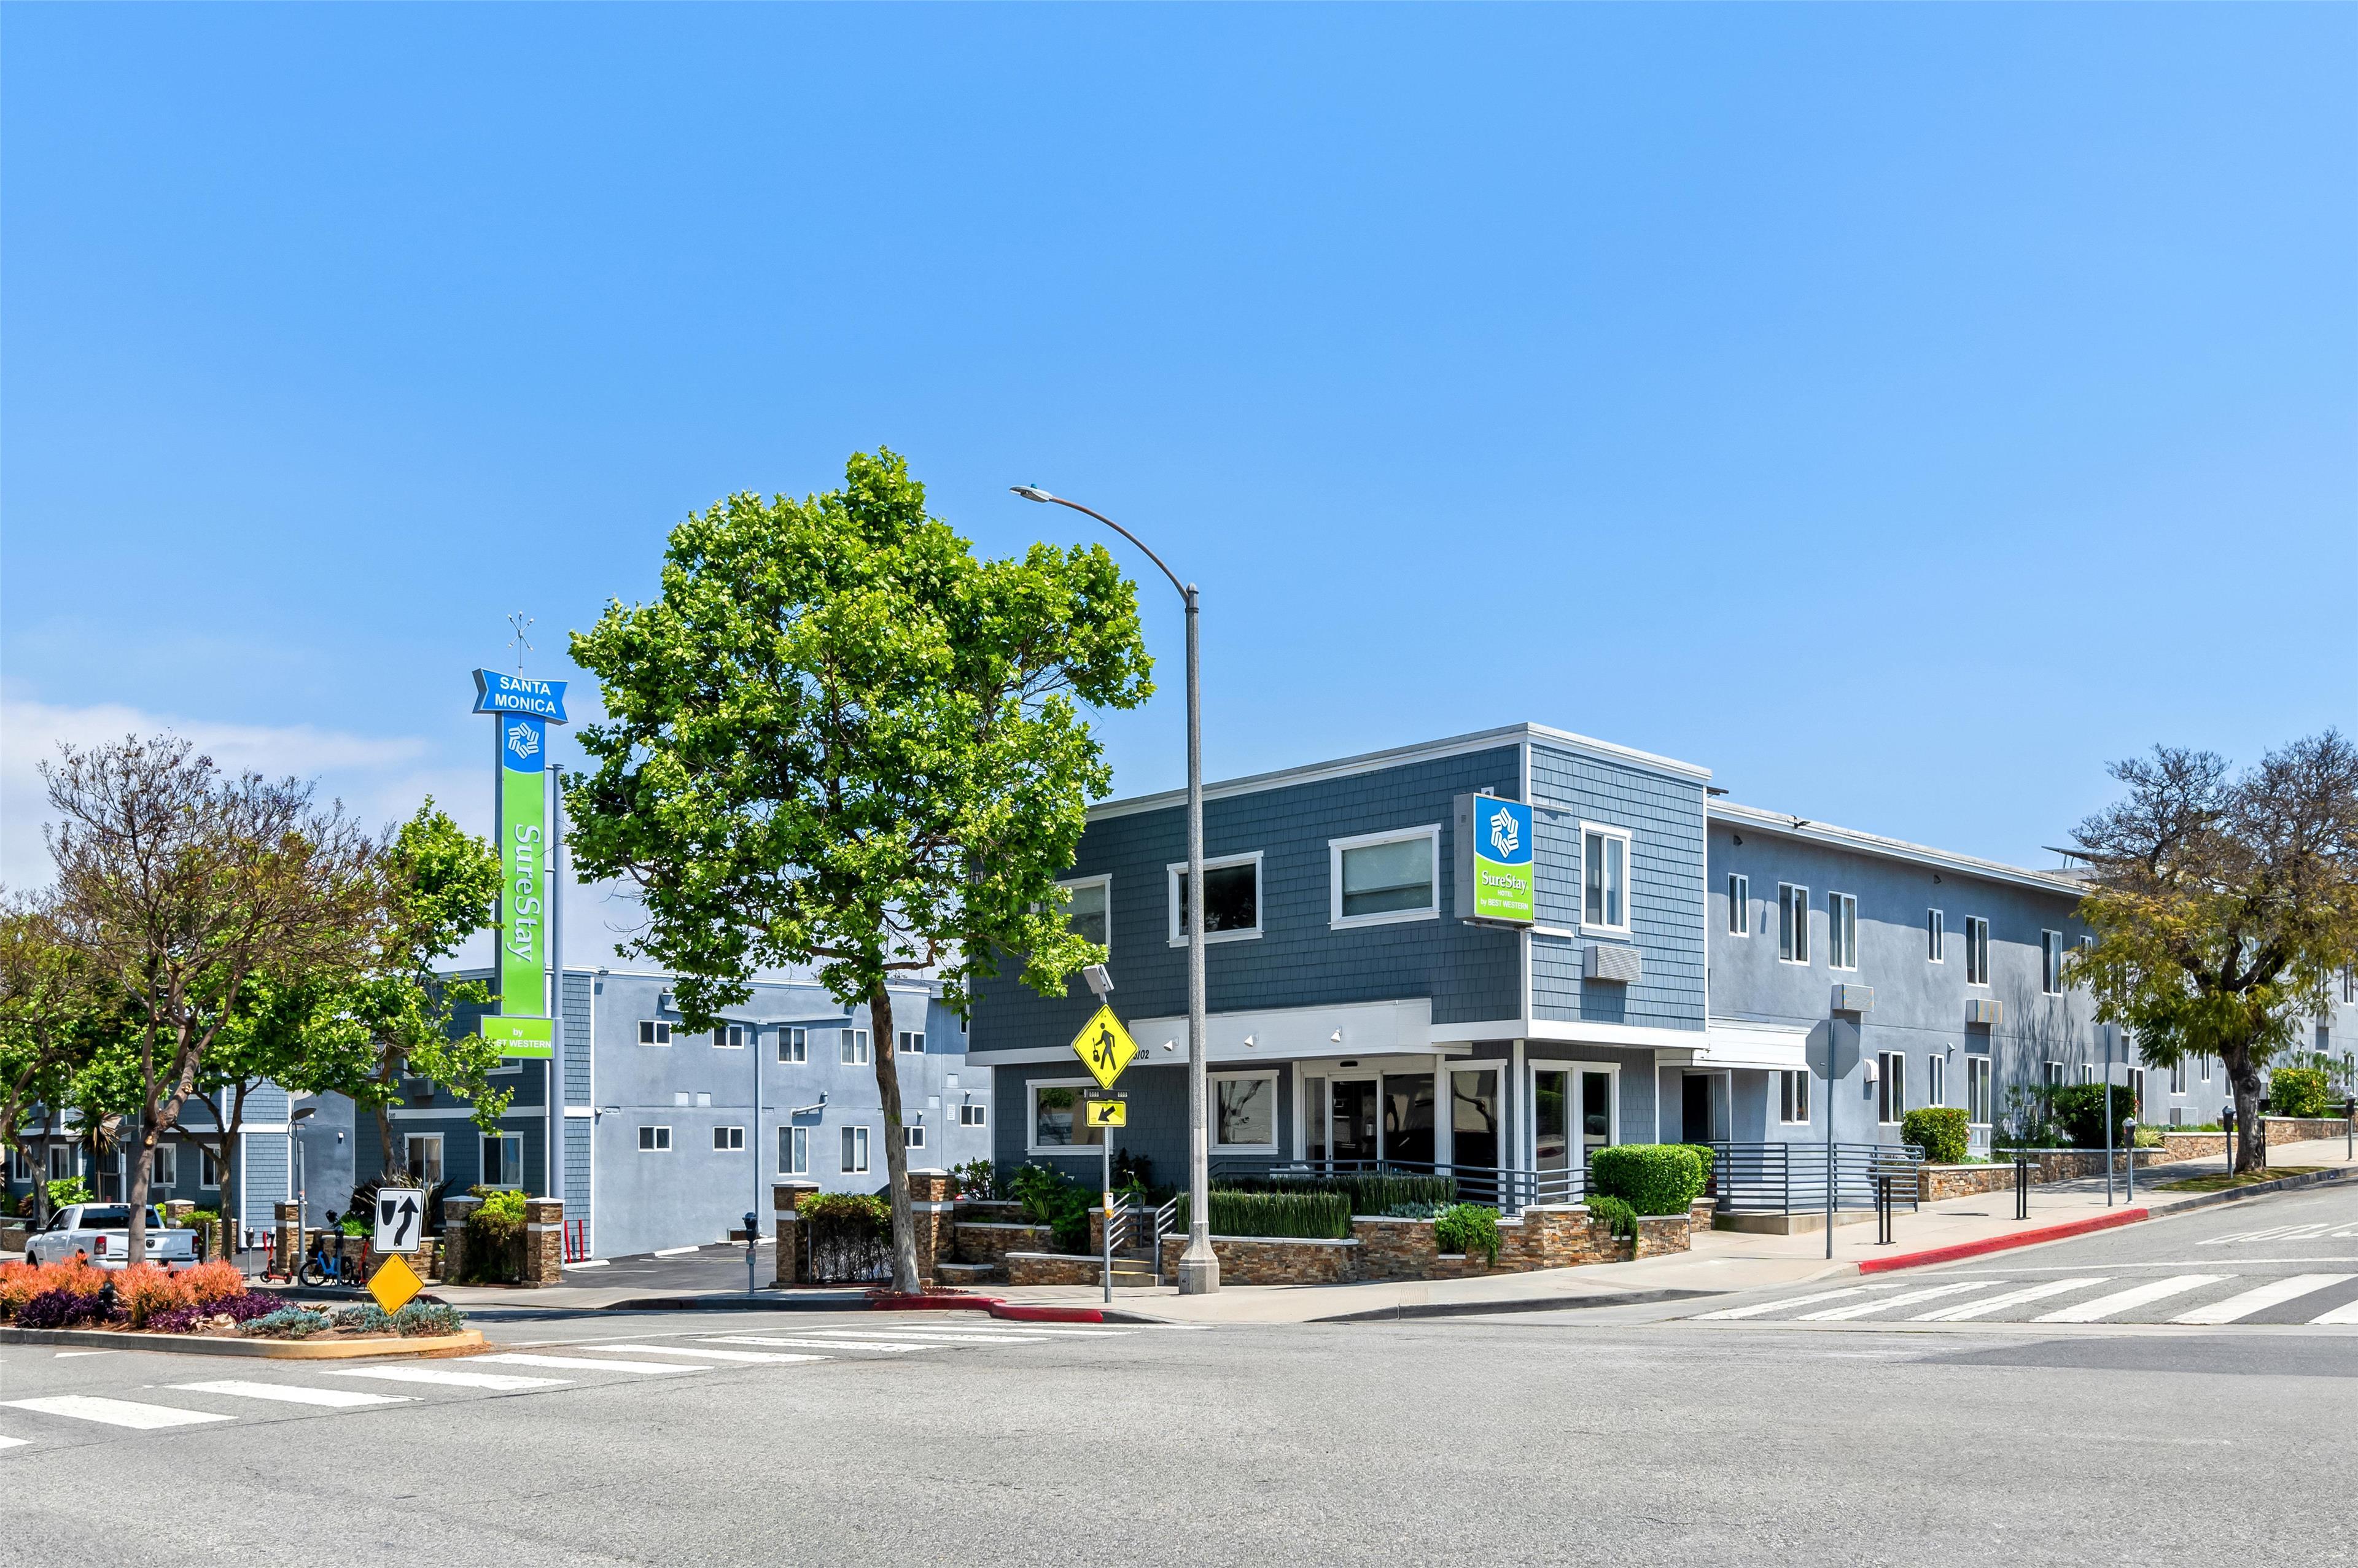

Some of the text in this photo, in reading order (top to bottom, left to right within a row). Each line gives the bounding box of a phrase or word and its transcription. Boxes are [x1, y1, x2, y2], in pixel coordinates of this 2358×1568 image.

[500, 677, 551, 696] SANTA
[495, 693, 556, 714] MONICA
[1482, 870, 1527, 895] SureStay
[506, 824, 540, 963] SureStay
[1481, 898, 1528, 910] by BEST WESTERN
[513, 1028, 523, 1037] by
[509, 1039, 551, 1048] WESTERN
